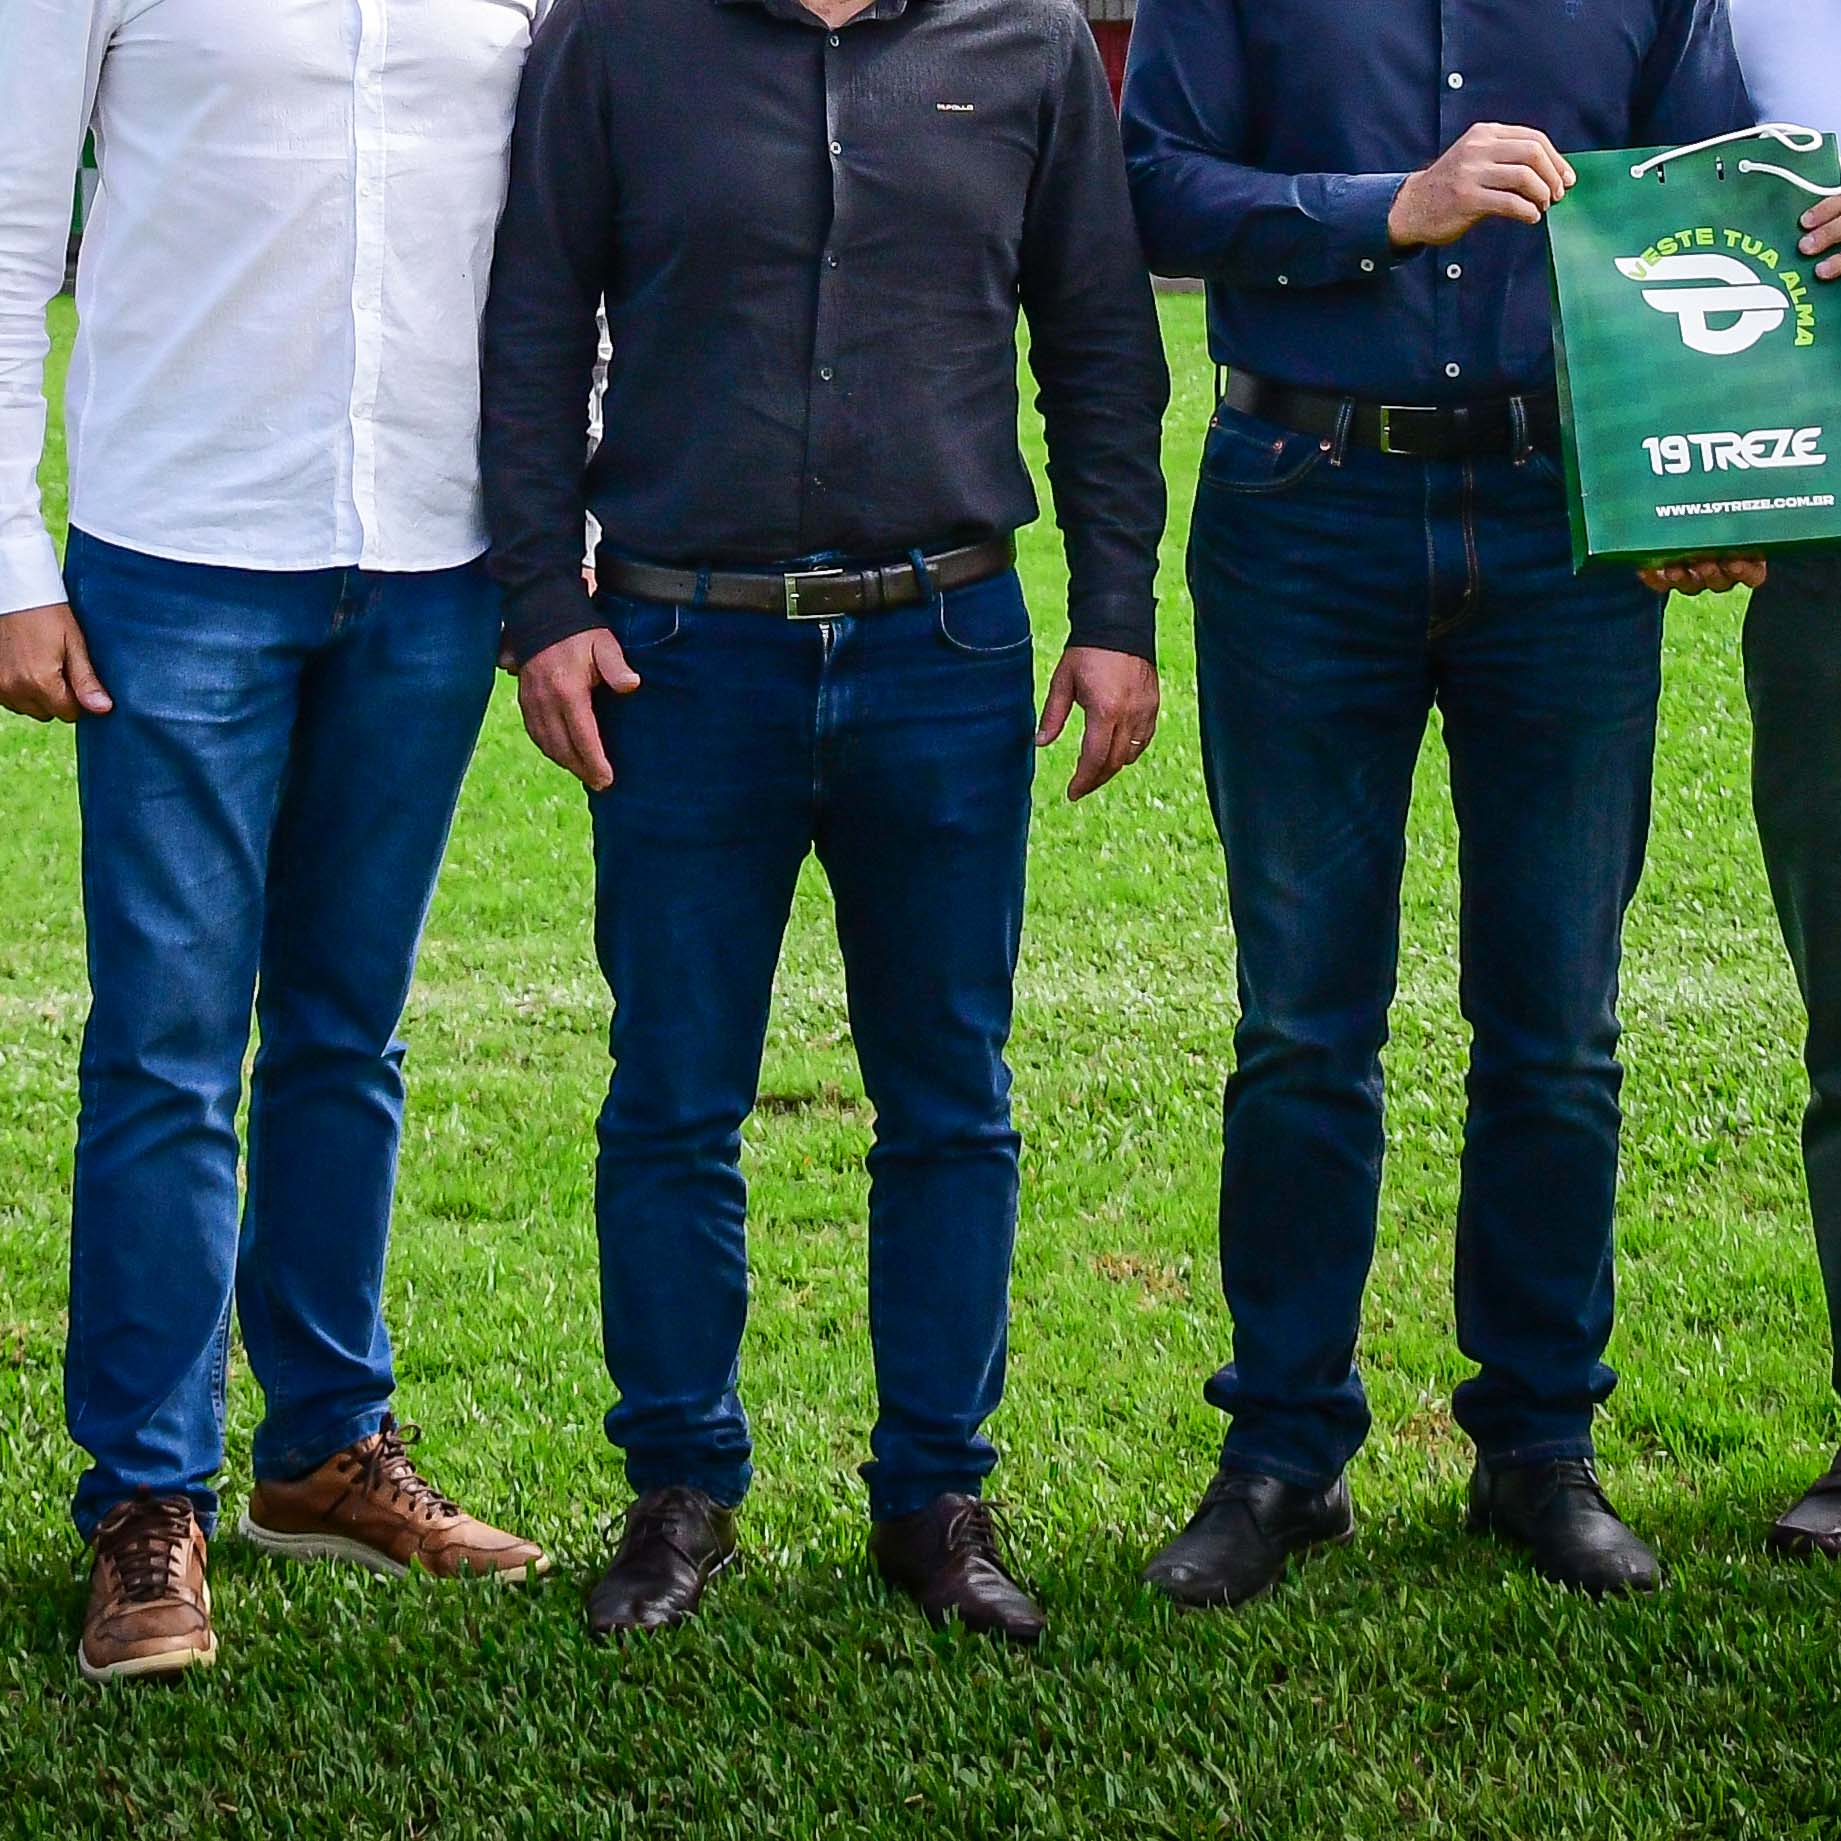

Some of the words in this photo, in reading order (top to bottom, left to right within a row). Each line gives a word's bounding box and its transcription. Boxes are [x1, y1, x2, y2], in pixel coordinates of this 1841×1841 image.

[1628, 227, 1714, 279] VESTE
[1723, 229, 1780, 270] TUA
[1778, 271, 1815, 347] ALMA
